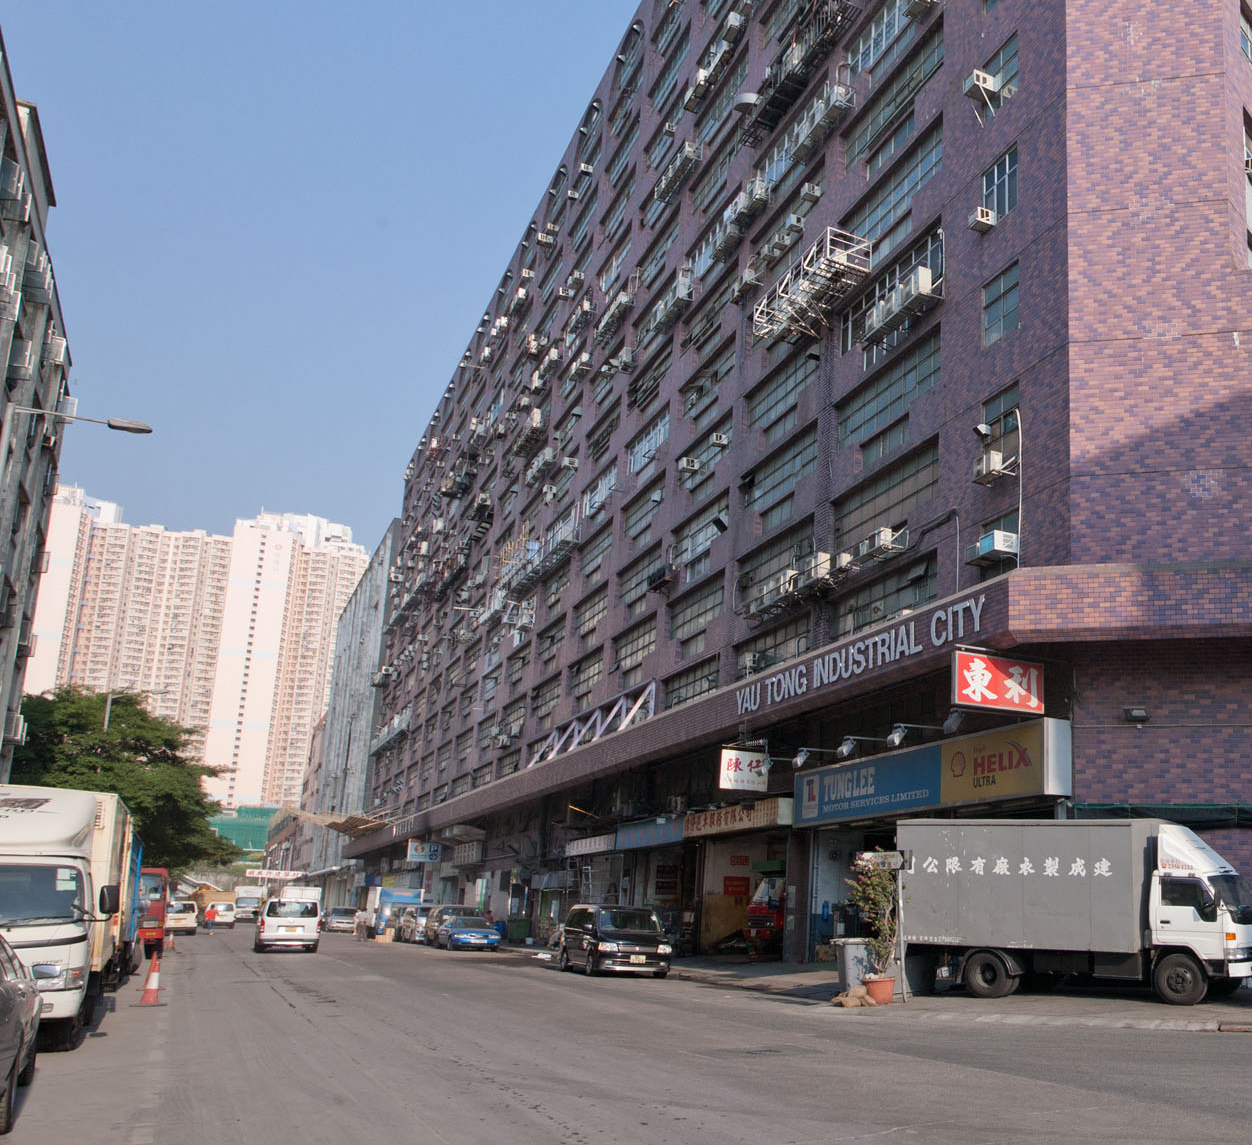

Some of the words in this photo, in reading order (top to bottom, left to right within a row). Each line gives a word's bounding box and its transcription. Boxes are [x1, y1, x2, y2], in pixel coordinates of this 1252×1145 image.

[736, 684, 761, 716] YAU
[764, 665, 808, 705] TONG
[812, 621, 924, 689] INDUSTRIAL
[930, 594, 986, 646] CITY
[961, 657, 1040, 709] 東利
[973, 743, 1031, 776] HELIX
[972, 774, 997, 789] ULTRA
[822, 801, 849, 813] MOTOR
[850, 794, 890, 809] SERVICES
[891, 789, 929, 803] LIMITED
